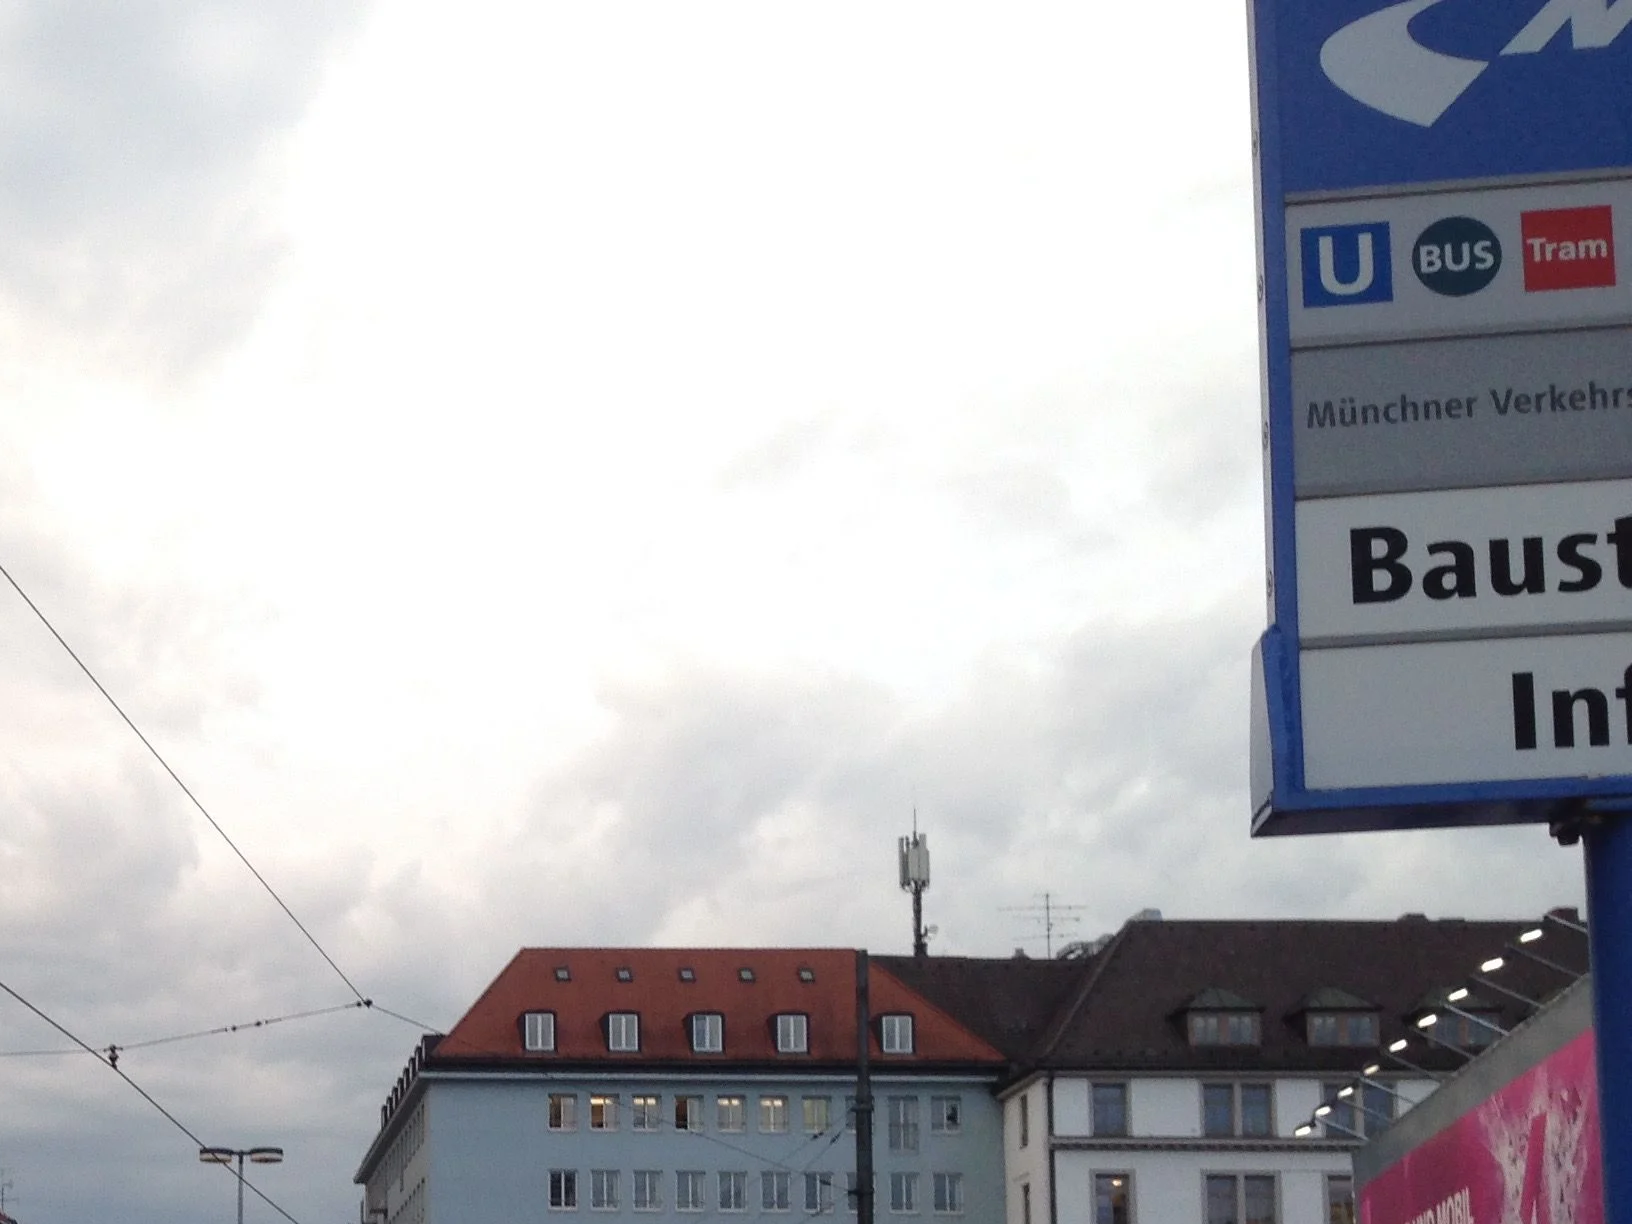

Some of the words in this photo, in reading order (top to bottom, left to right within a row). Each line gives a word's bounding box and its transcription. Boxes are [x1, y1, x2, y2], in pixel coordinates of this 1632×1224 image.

[1318, 232, 1374, 296] U
[1418, 240, 1495, 274] BUS
[1526, 236, 1608, 263] Tram
[1307, 393, 1478, 429] Münchner
